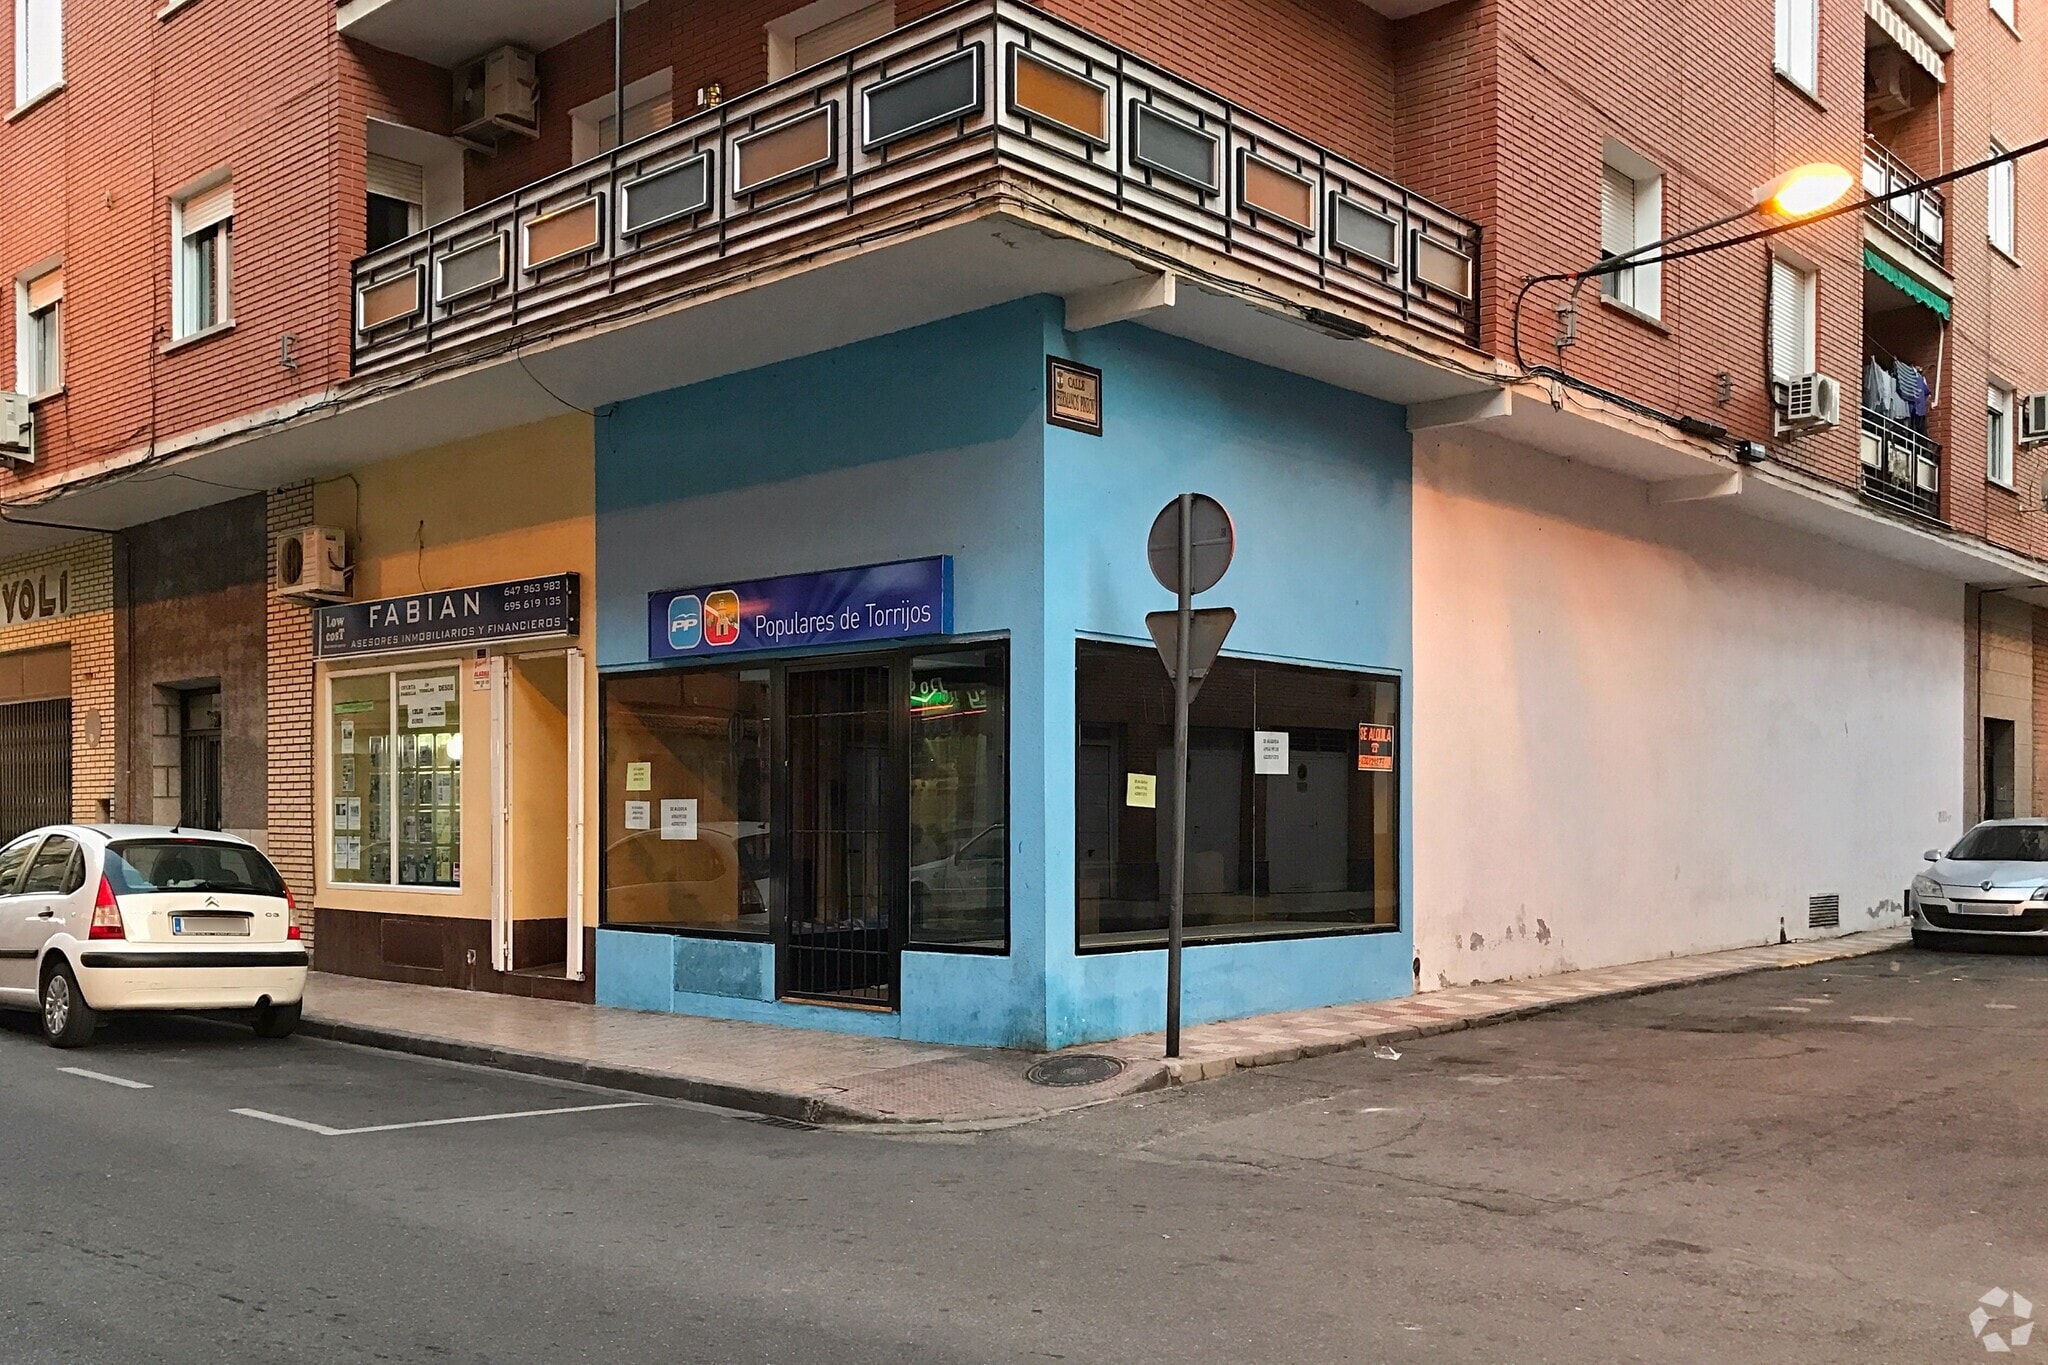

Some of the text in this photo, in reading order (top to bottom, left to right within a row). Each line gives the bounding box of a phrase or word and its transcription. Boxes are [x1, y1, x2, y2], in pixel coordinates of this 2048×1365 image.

[1067, 377, 1086, 391] CALLE
[2, 570, 68, 624] YOLI
[504, 580, 561, 597] 647 963 983
[369, 591, 481, 629] FABIAN
[504, 596, 562, 612] 695 619 135
[671, 618, 698, 632] PP
[755, 599, 931, 643] Populares de Torrijos
[351, 616, 561, 649] ASESORES INMOBILIARIOS Y FINANCIEROS
[1360, 726, 1392, 743] SE ALQUILA
